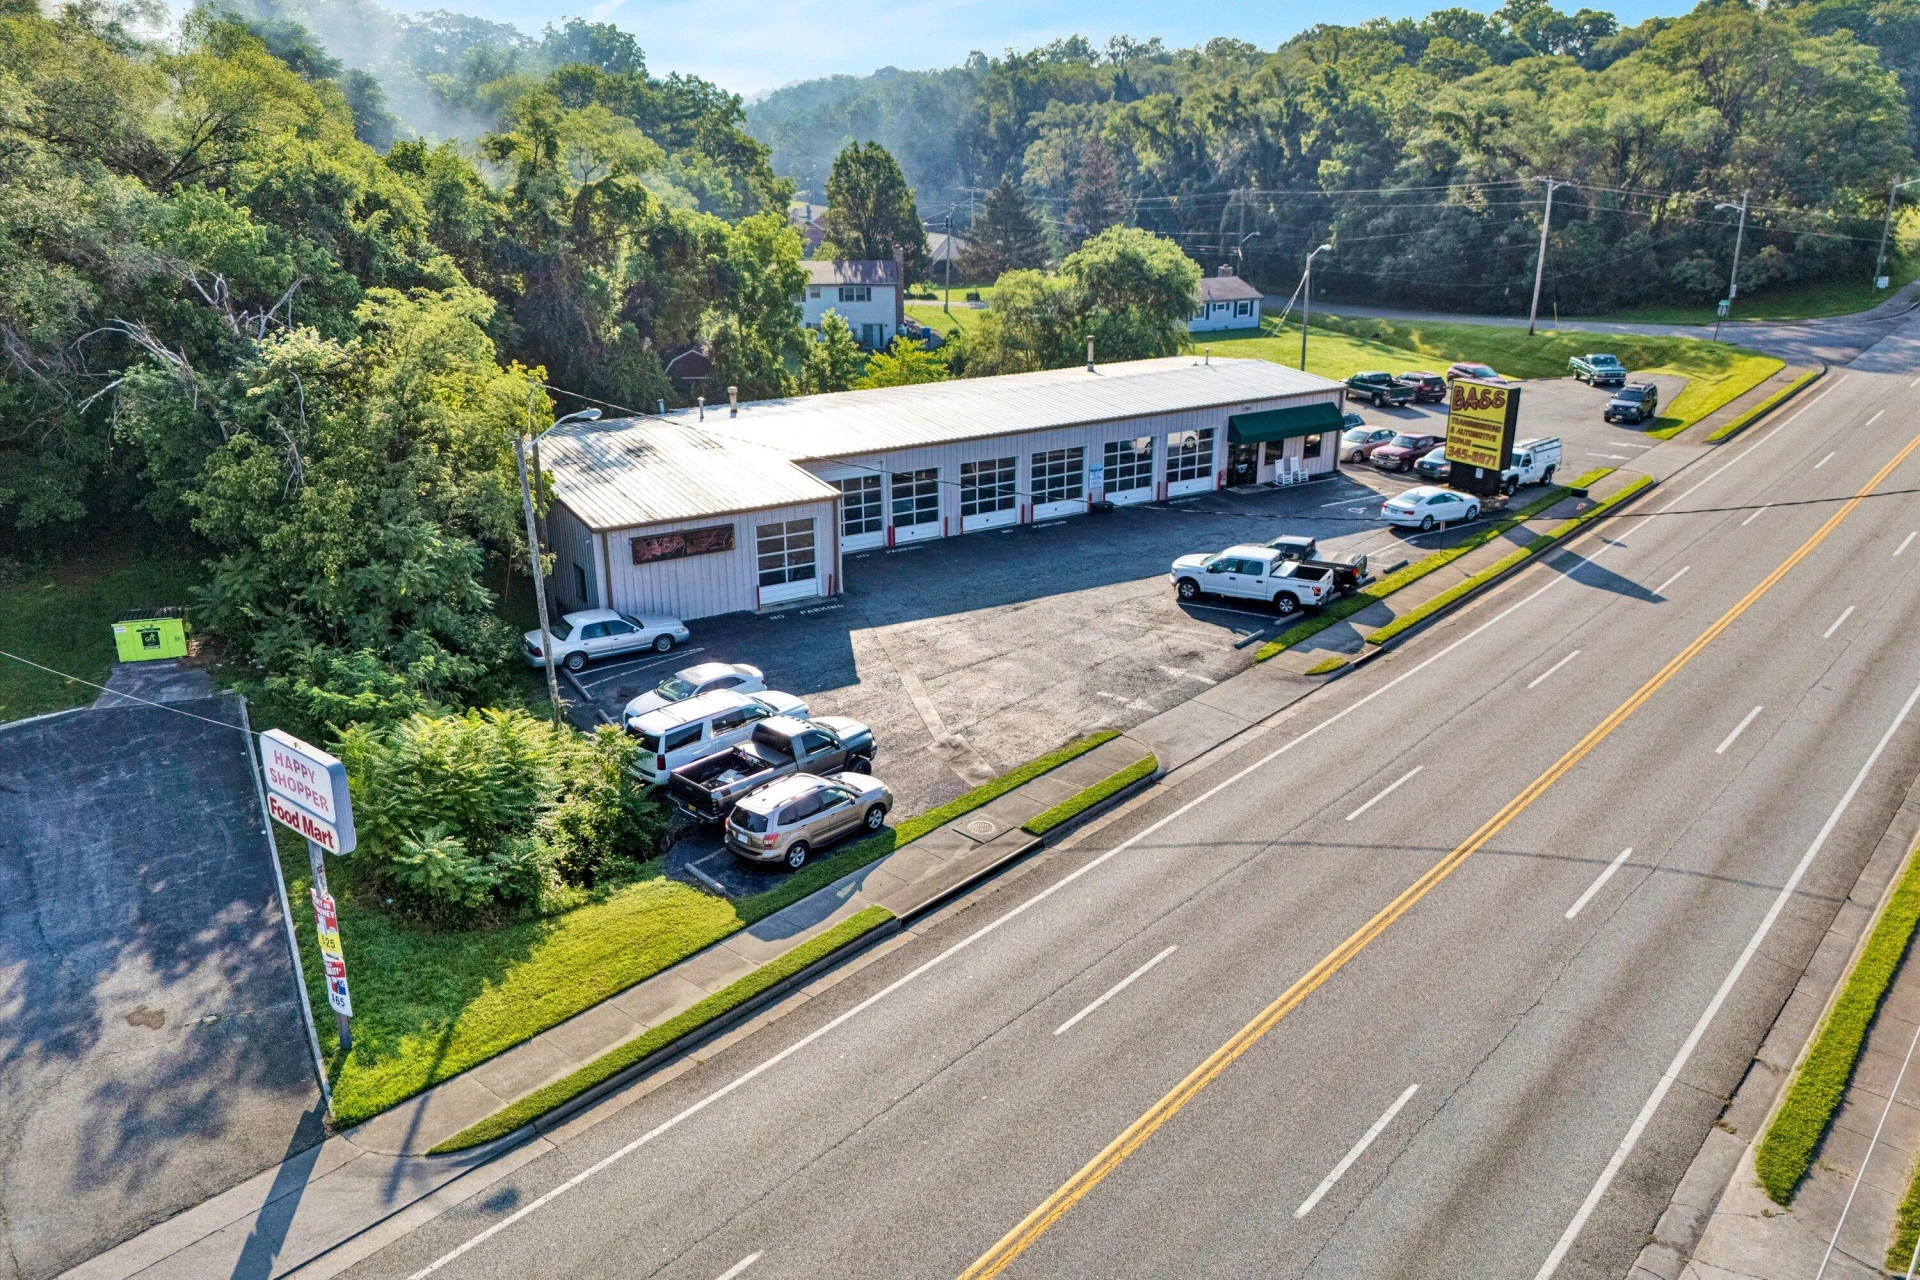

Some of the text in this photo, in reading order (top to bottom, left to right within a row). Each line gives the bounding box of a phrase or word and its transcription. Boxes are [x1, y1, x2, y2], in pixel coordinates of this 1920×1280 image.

[1452, 386, 1505, 411] BASS
[799, 603, 845, 615] PARKING
[273, 749, 316, 784] HAPPY
[269, 767, 329, 812] SHOPPER
[269, 795, 300, 831] Food
[301, 815, 335, 850] Mart
